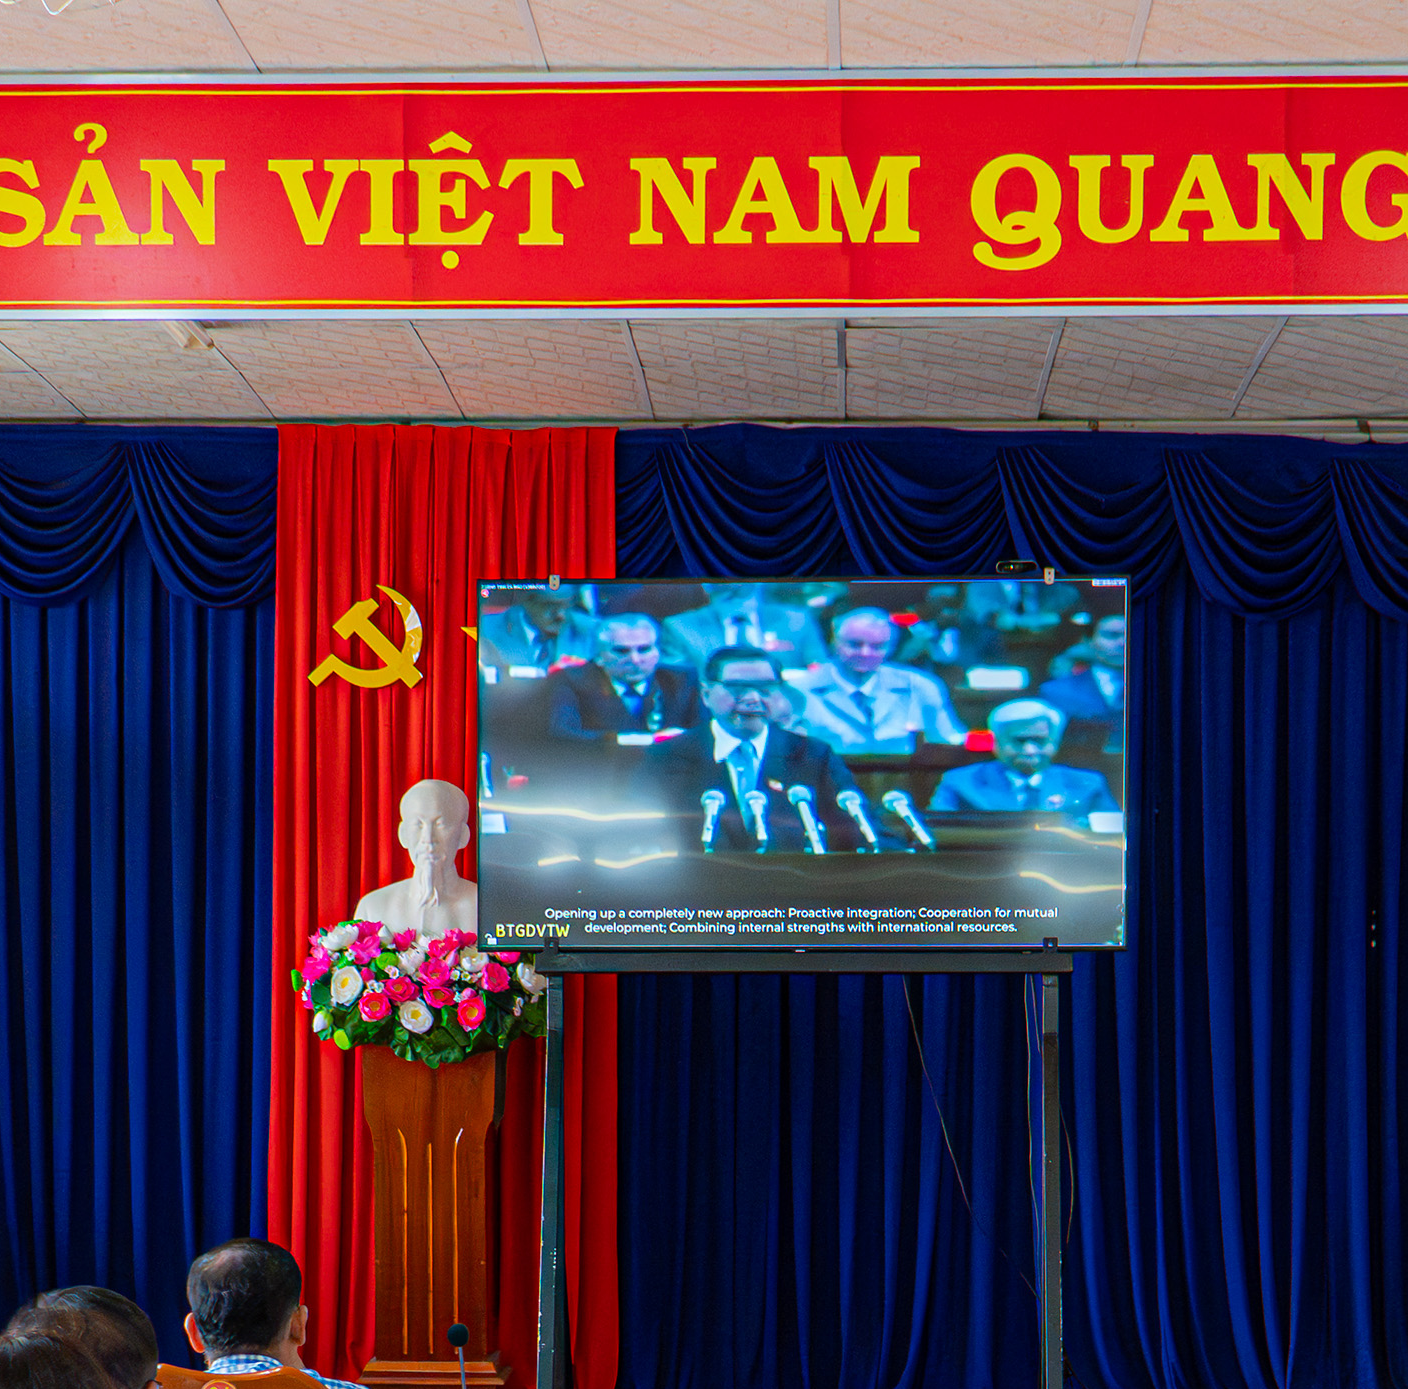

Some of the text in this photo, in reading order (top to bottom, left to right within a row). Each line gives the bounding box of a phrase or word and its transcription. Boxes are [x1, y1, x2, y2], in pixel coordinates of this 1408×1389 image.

[268, 131, 584, 269] VIỆT
[630, 156, 920, 244] NAM
[544, 907, 1058, 922] Opening up a completely new approach: Proactive integration; Cooperation for mutual
[495, 923, 570, 938] BTGDVTW
[584, 921, 1017, 935] development; Combining internal strengths with international resources.
